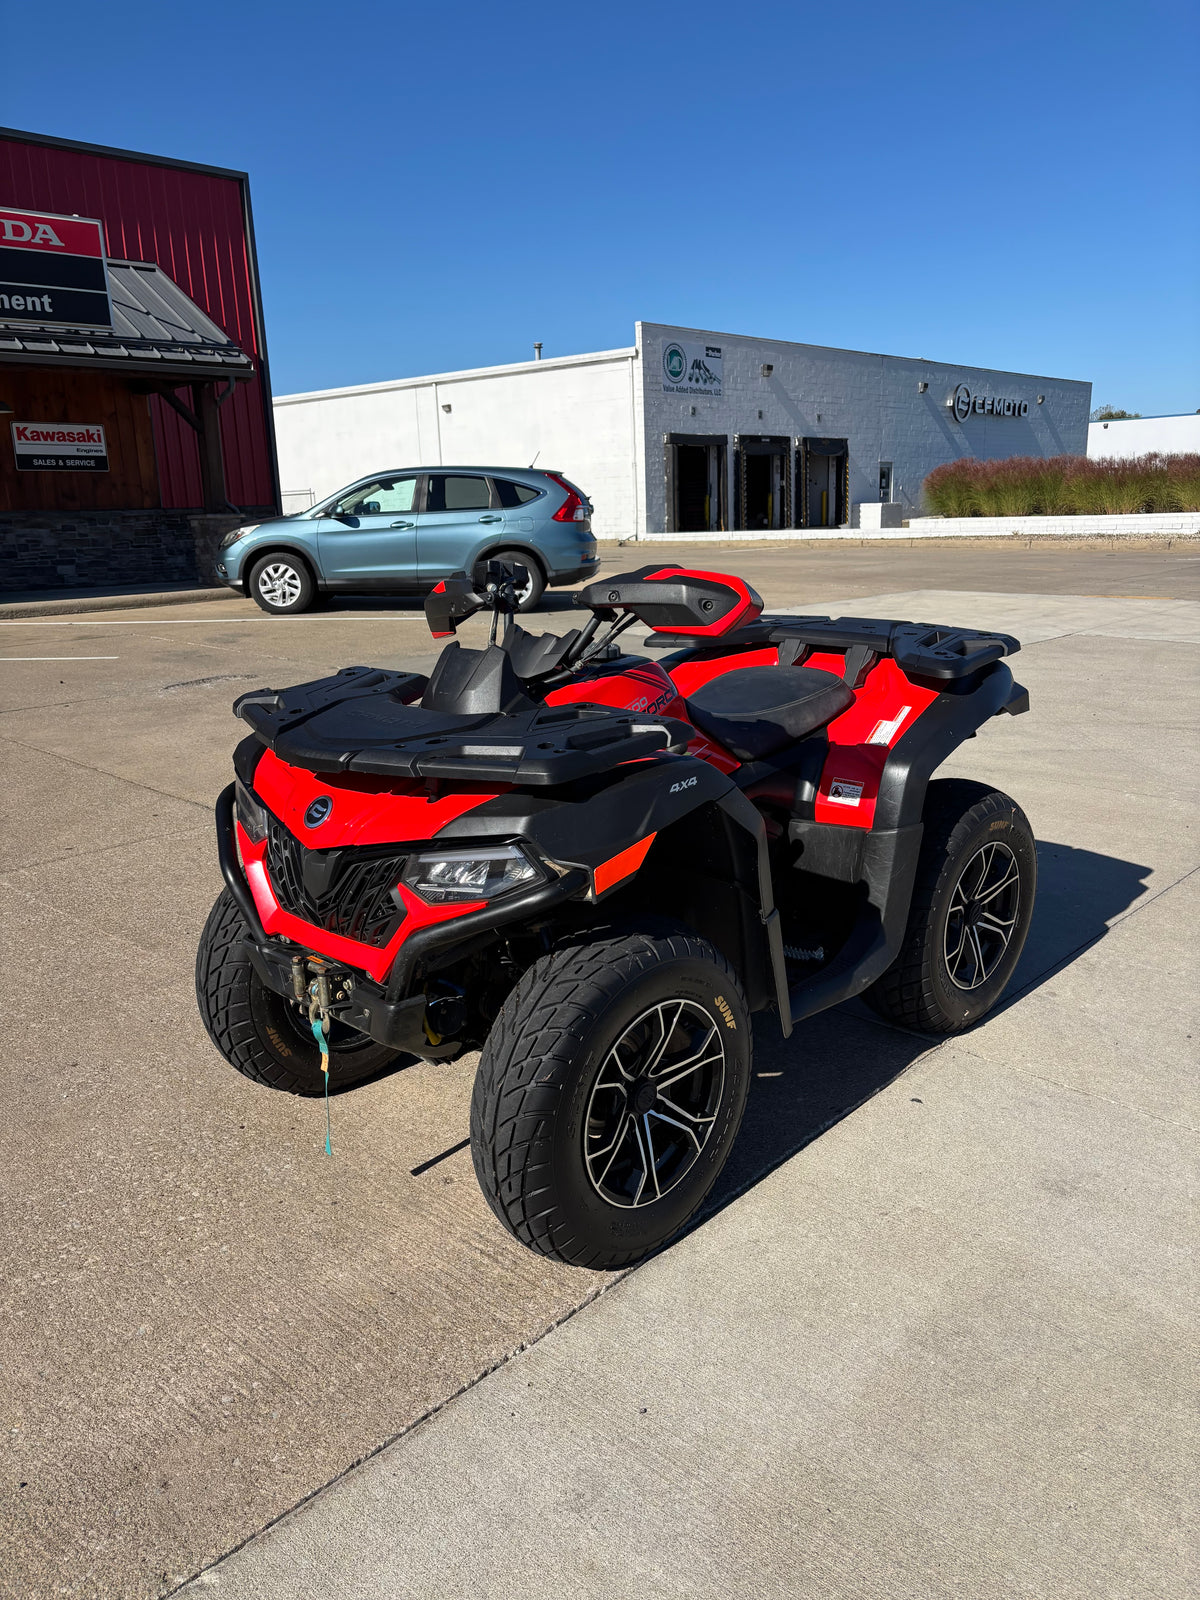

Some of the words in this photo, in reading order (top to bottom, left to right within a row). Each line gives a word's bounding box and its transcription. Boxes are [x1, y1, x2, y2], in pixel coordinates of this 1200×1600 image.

[663, 384, 675, 393] Value
[675, 385, 689, 394] Added
[974, 395, 1029, 417] CFMOTO
[15, 426, 102, 443] Kawasaki
[76, 447, 104, 455] Engines
[32, 458, 56, 466] SALES
[714, 995, 737, 1030] SUNF
[265, 1025, 293, 1057] SUNF
